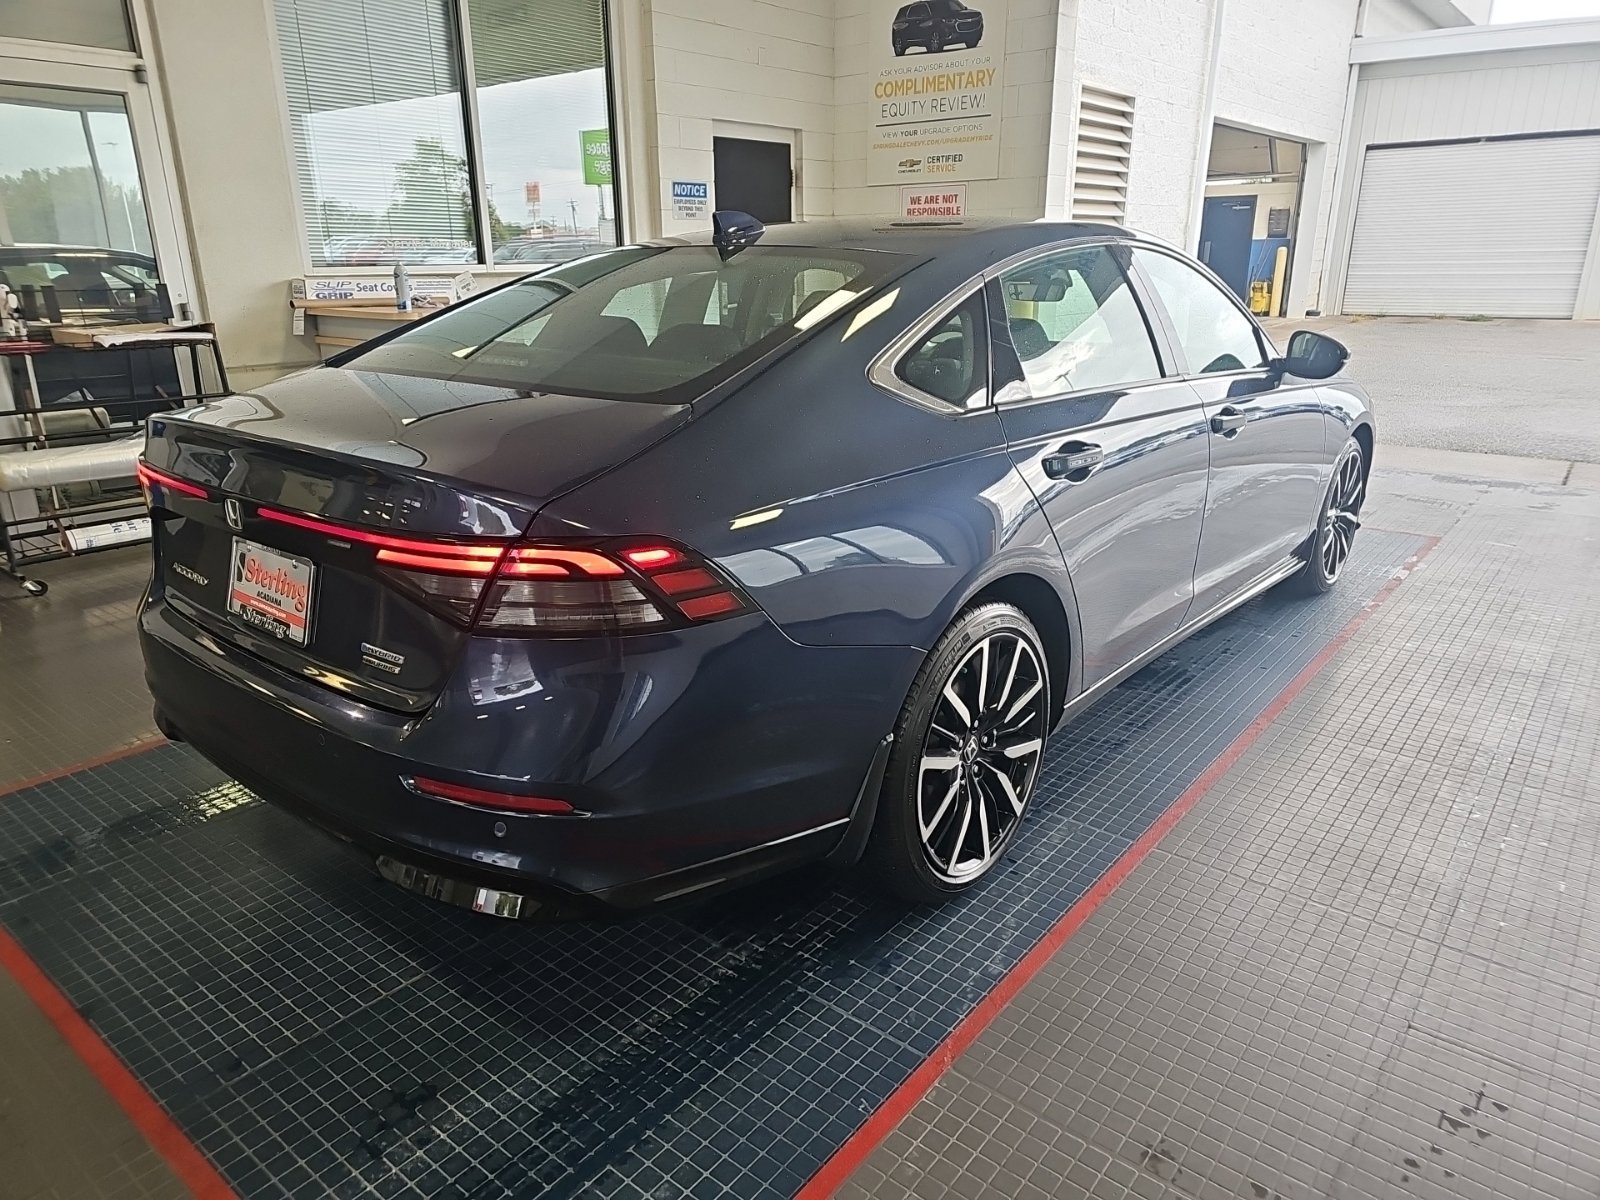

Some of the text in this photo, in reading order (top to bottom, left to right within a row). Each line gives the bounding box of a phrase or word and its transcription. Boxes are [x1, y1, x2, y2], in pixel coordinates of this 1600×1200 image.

[914, 62, 944, 73] ADVISOR
[945, 59, 969, 69] ABOUT
[874, 67, 996, 99] COMPLIMENTARY
[881, 93, 986, 119] EQUITY REVIEW!
[900, 129, 918, 137] YOUR
[919, 126, 951, 136] UPGRADE
[952, 124, 983, 133] OPTIONS
[926, 153, 963, 165] CERTIFIED
[926, 163, 957, 173] SERVICE
[674, 183, 706, 197] NOTICE
[909, 193, 959, 205] WE ARE NOT
[906, 205, 961, 217] RESPONSIBLE
[315, 281, 352, 289] SLIP
[356, 282, 378, 293] Seat
[172, 562, 209, 585] ACCORD
[244, 558, 306, 613] Sterling
[243, 606, 287, 638] Sterling
[367, 646, 401, 661] HYBRID
